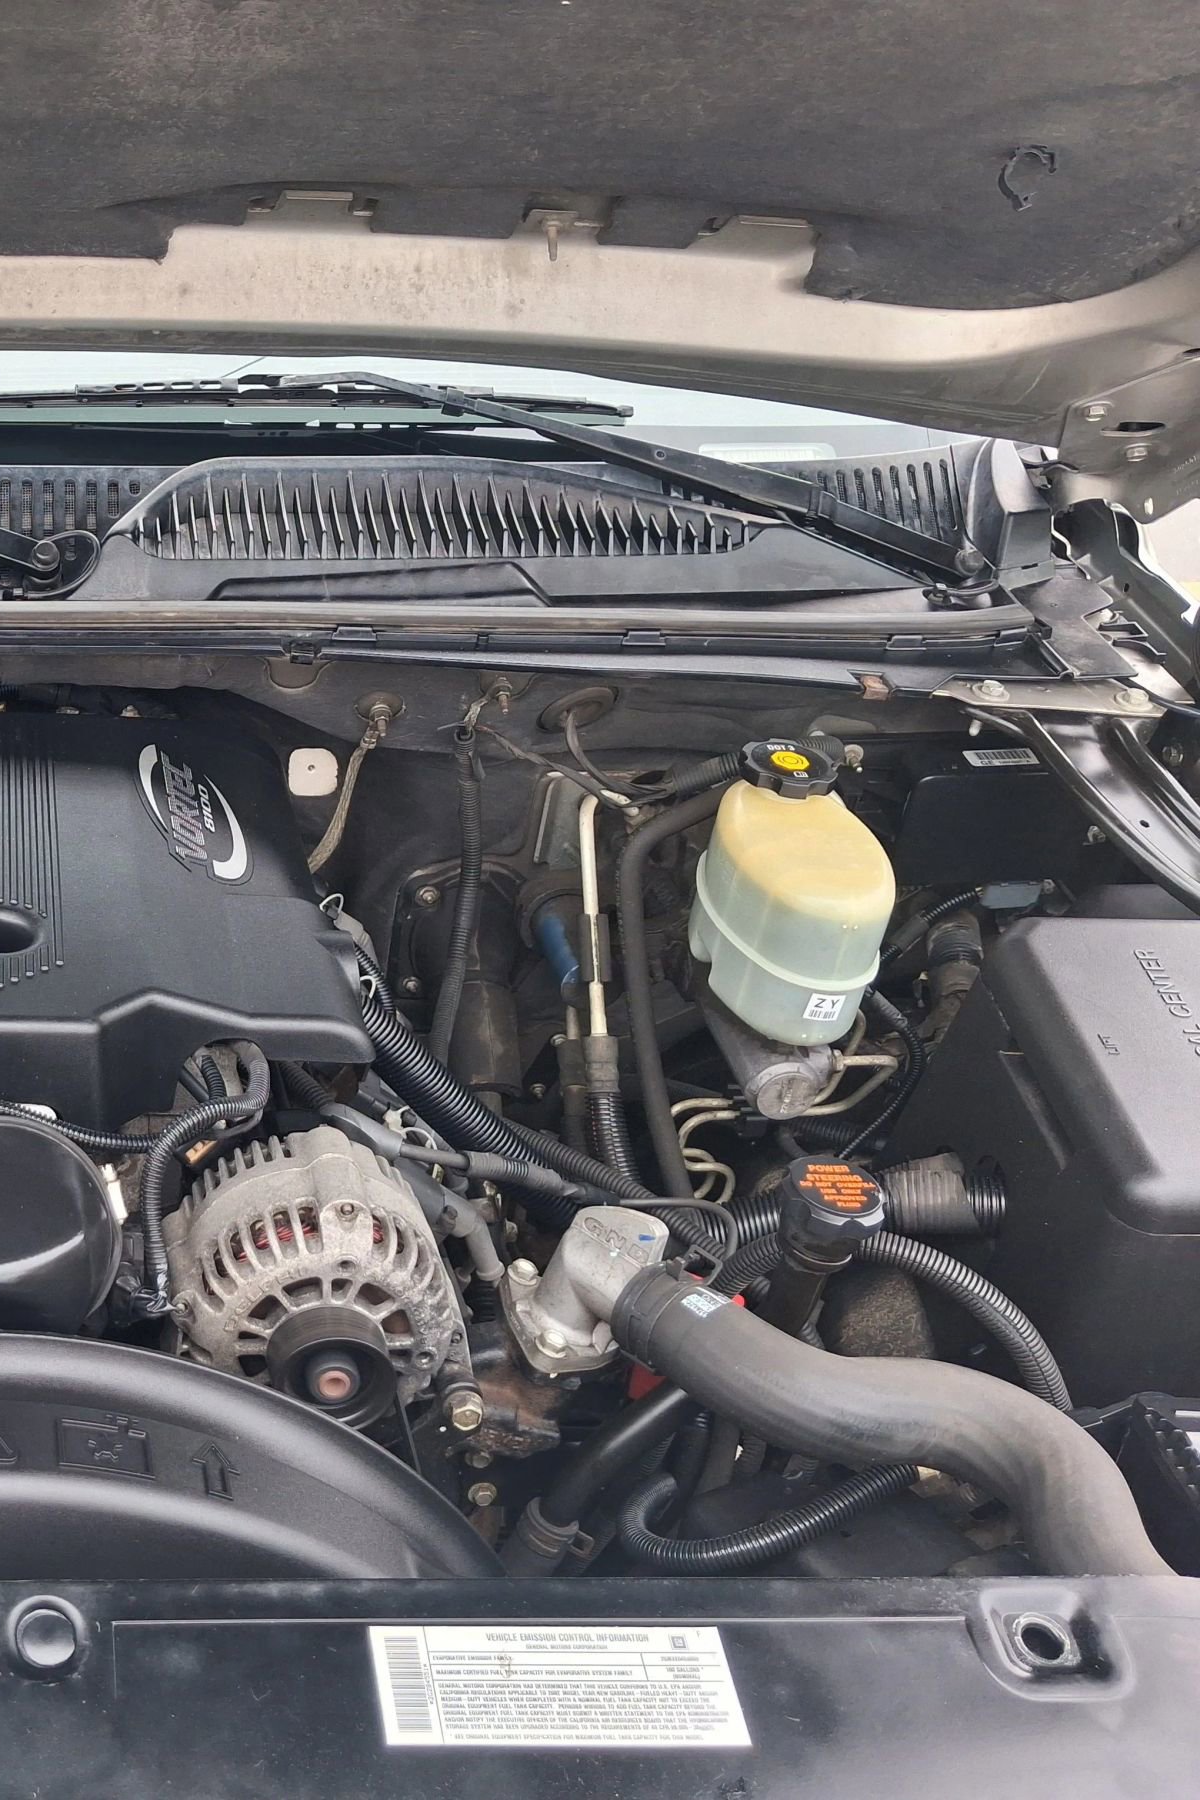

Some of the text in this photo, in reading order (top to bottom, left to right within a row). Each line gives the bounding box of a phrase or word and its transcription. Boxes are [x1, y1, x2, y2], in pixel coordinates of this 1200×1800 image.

[160, 750, 208, 860] VORTEC
[198, 784, 215, 833] 8100
[1133, 949, 1192, 1018] CENTER
[806, 1173, 863, 1182] STEERING
[807, 1164, 850, 1172] POWER
[486, 1633, 649, 1642] VEHICLE EMISSION CONTROL INFORMATION
